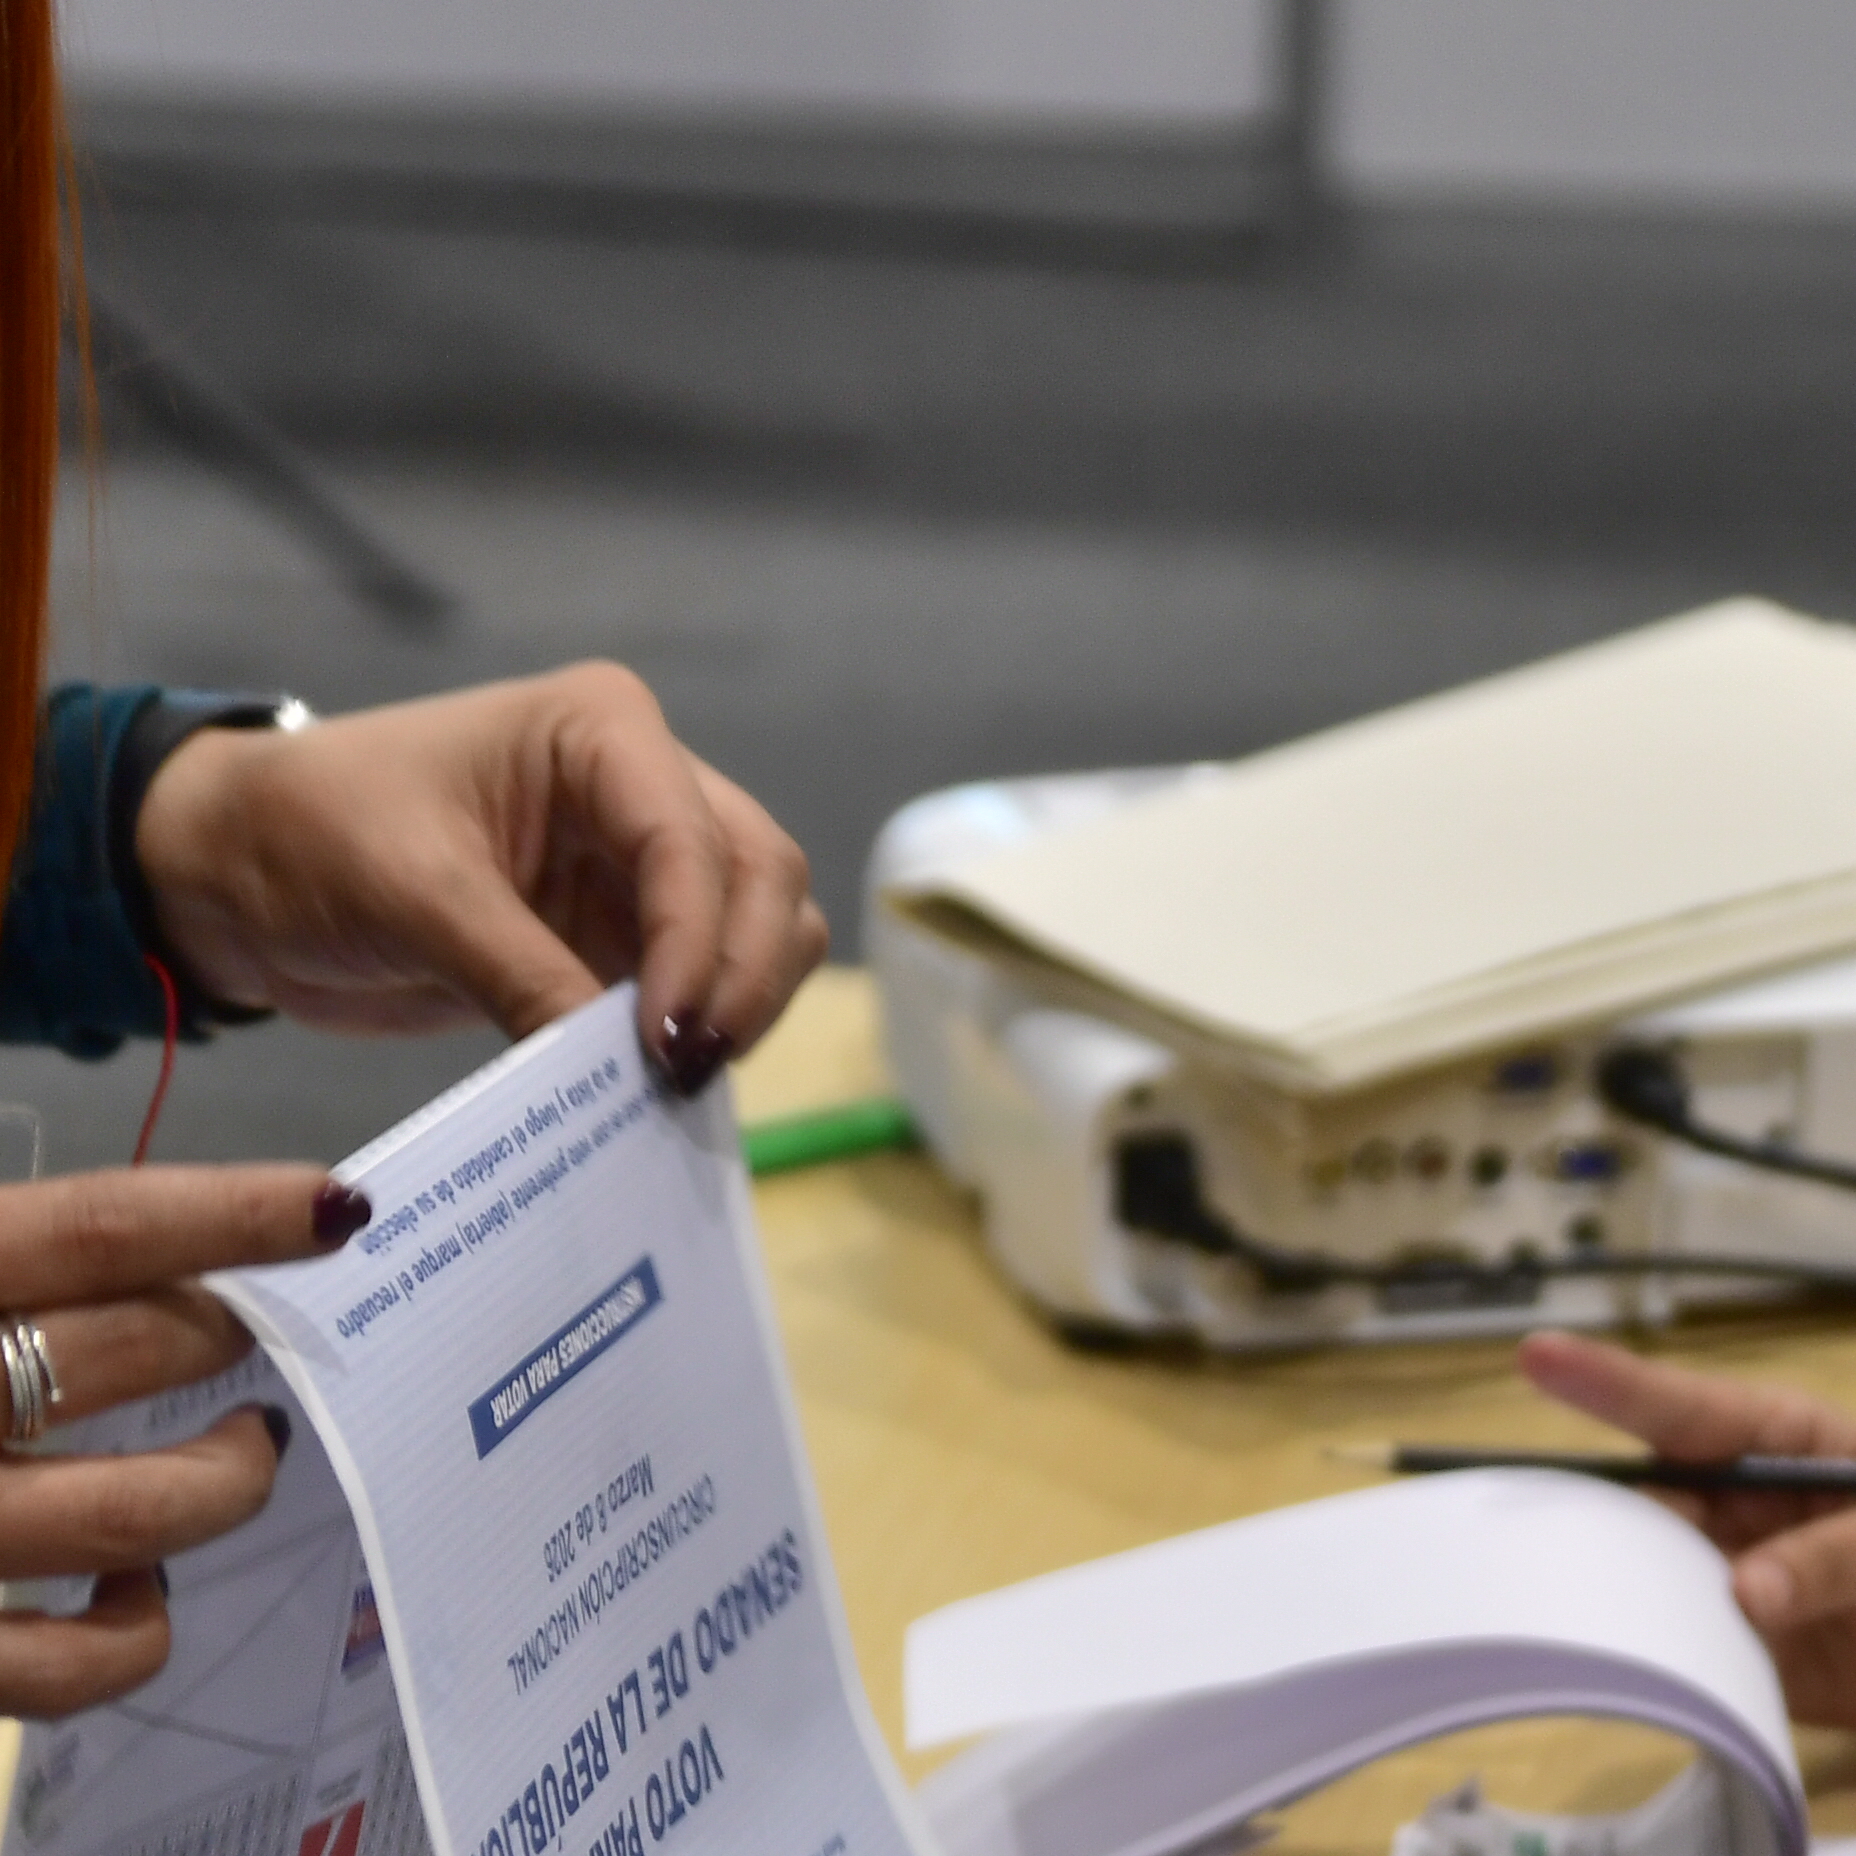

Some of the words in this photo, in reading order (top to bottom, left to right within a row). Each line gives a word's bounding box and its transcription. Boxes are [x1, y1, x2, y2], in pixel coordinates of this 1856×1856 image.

[521, 1097, 561, 1141] luego
[554, 1084, 568, 1115] y
[449, 1130, 514, 1196] candidato
[510, 1121, 528, 1157] el
[414, 1187, 436, 1219] su
[430, 1173, 455, 1213] de
[509, 1145, 569, 1216] preferente
[455, 1186, 513, 1259] (abierta)
[396, 1267, 415, 1305] el
[410, 1231, 461, 1287] marque
[335, 1276, 401, 1348] recuadro
[555, 1273, 647, 1370] INSTRUCCIONES
[488, 1373, 530, 1429] VOTAR
[525, 1344, 562, 1395] PARA
[592, 1491, 609, 1535] 8
[605, 1452, 657, 1517] Marzo
[540, 1519, 578, 1584] 2026
[572, 1502, 598, 1551] de
[575, 1469, 717, 1631] CIRCUNSCRIPCIÓN
[686, 1525, 807, 1683] SENADO
[507, 1591, 582, 1698] NACIONAL
[642, 1626, 695, 1719] DE
[604, 1667, 653, 1755] LA
[638, 1718, 724, 1847] VOTO
